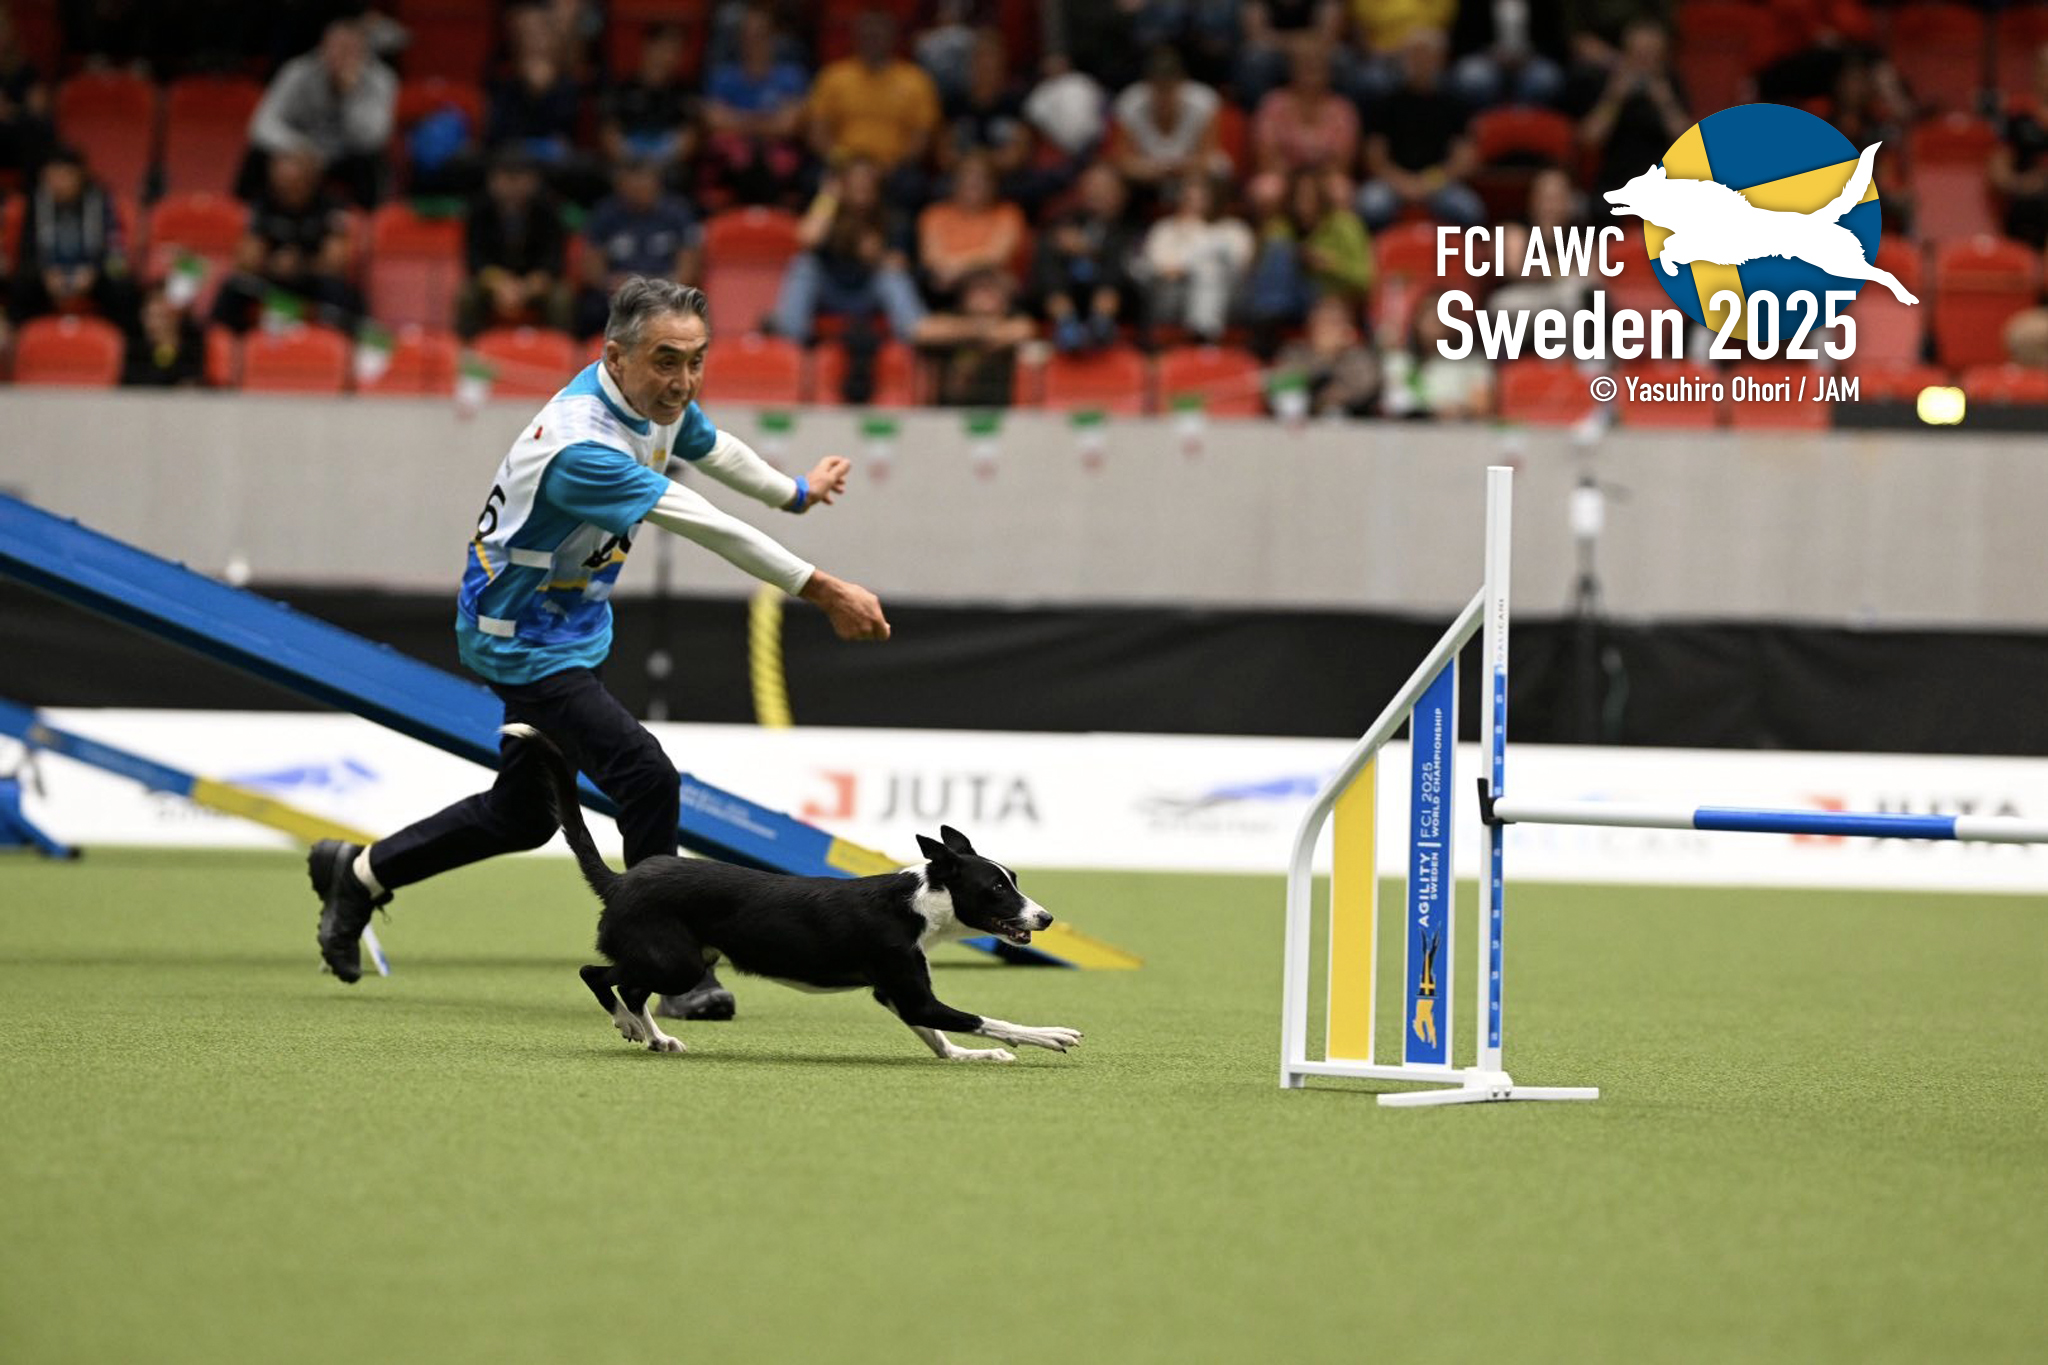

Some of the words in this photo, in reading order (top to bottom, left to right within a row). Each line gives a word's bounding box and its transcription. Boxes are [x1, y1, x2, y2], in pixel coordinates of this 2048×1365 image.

[1433, 707, 1443, 794] CHAMPIONSHIP
[880, 772, 1042, 824] JUTA
[1421, 761, 1434, 802] 2025
[1420, 809, 1433, 838] FCI
[1431, 795, 1441, 838] WORLD
[1418, 851, 1431, 928] AGILITY
[1430, 851, 1440, 900] SWEDEN
